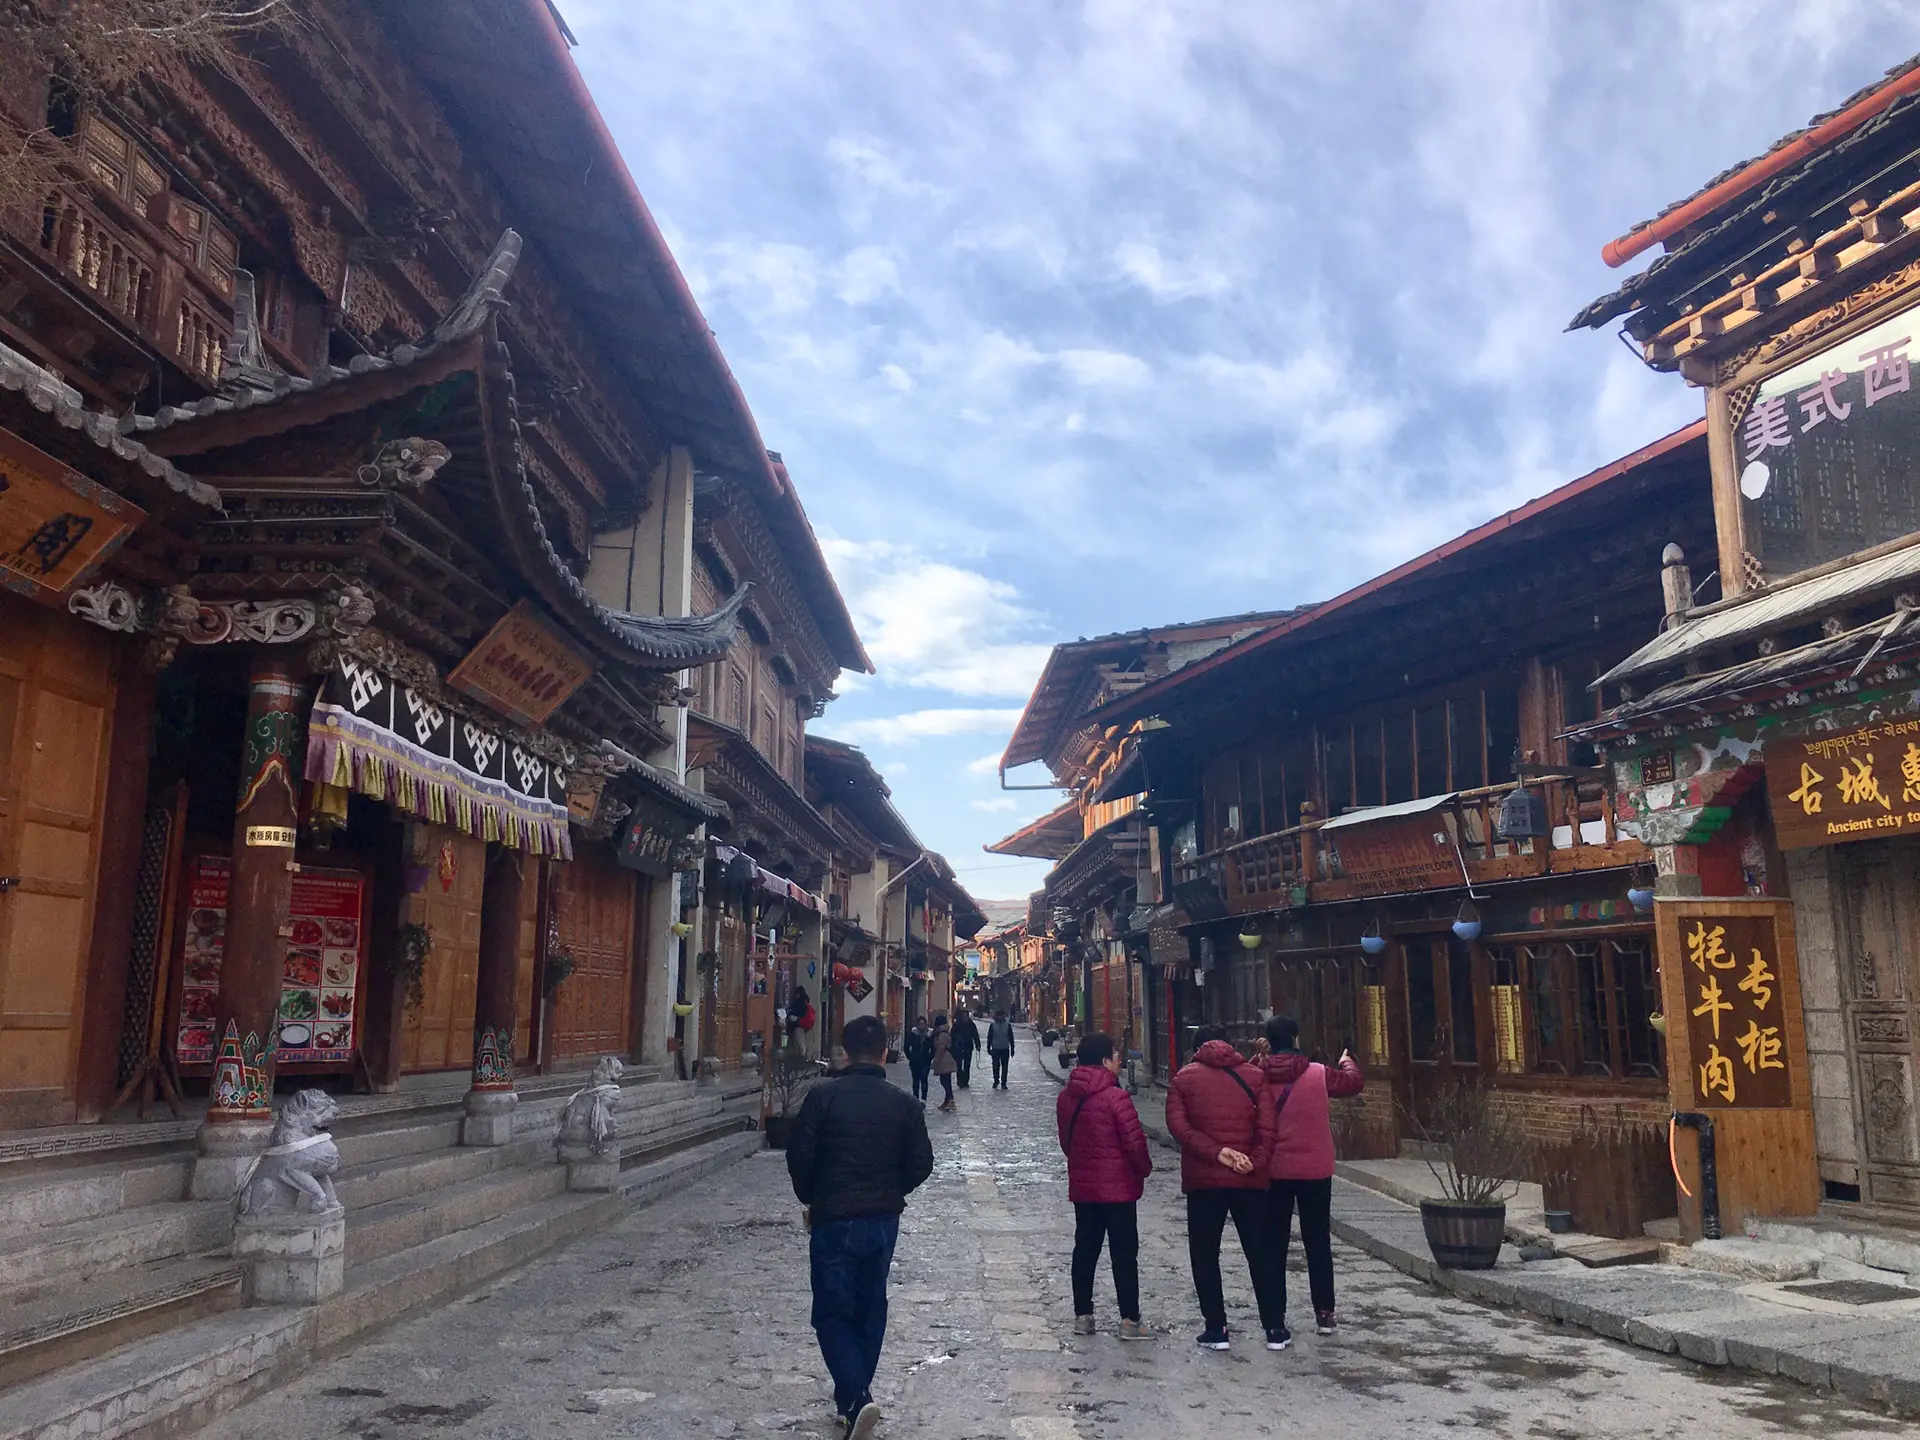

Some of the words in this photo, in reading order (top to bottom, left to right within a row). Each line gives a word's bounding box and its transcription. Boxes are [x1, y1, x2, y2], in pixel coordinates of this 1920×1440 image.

[1743, 335, 1912, 462] 美式西
[1426, 859, 1455, 874] FLOOR
[1827, 817, 1874, 836] Ancient
[1876, 813, 1903, 829] city
[1685, 921, 1736, 1104] 牦牛肉
[1735, 948, 1785, 1075] 专柜
